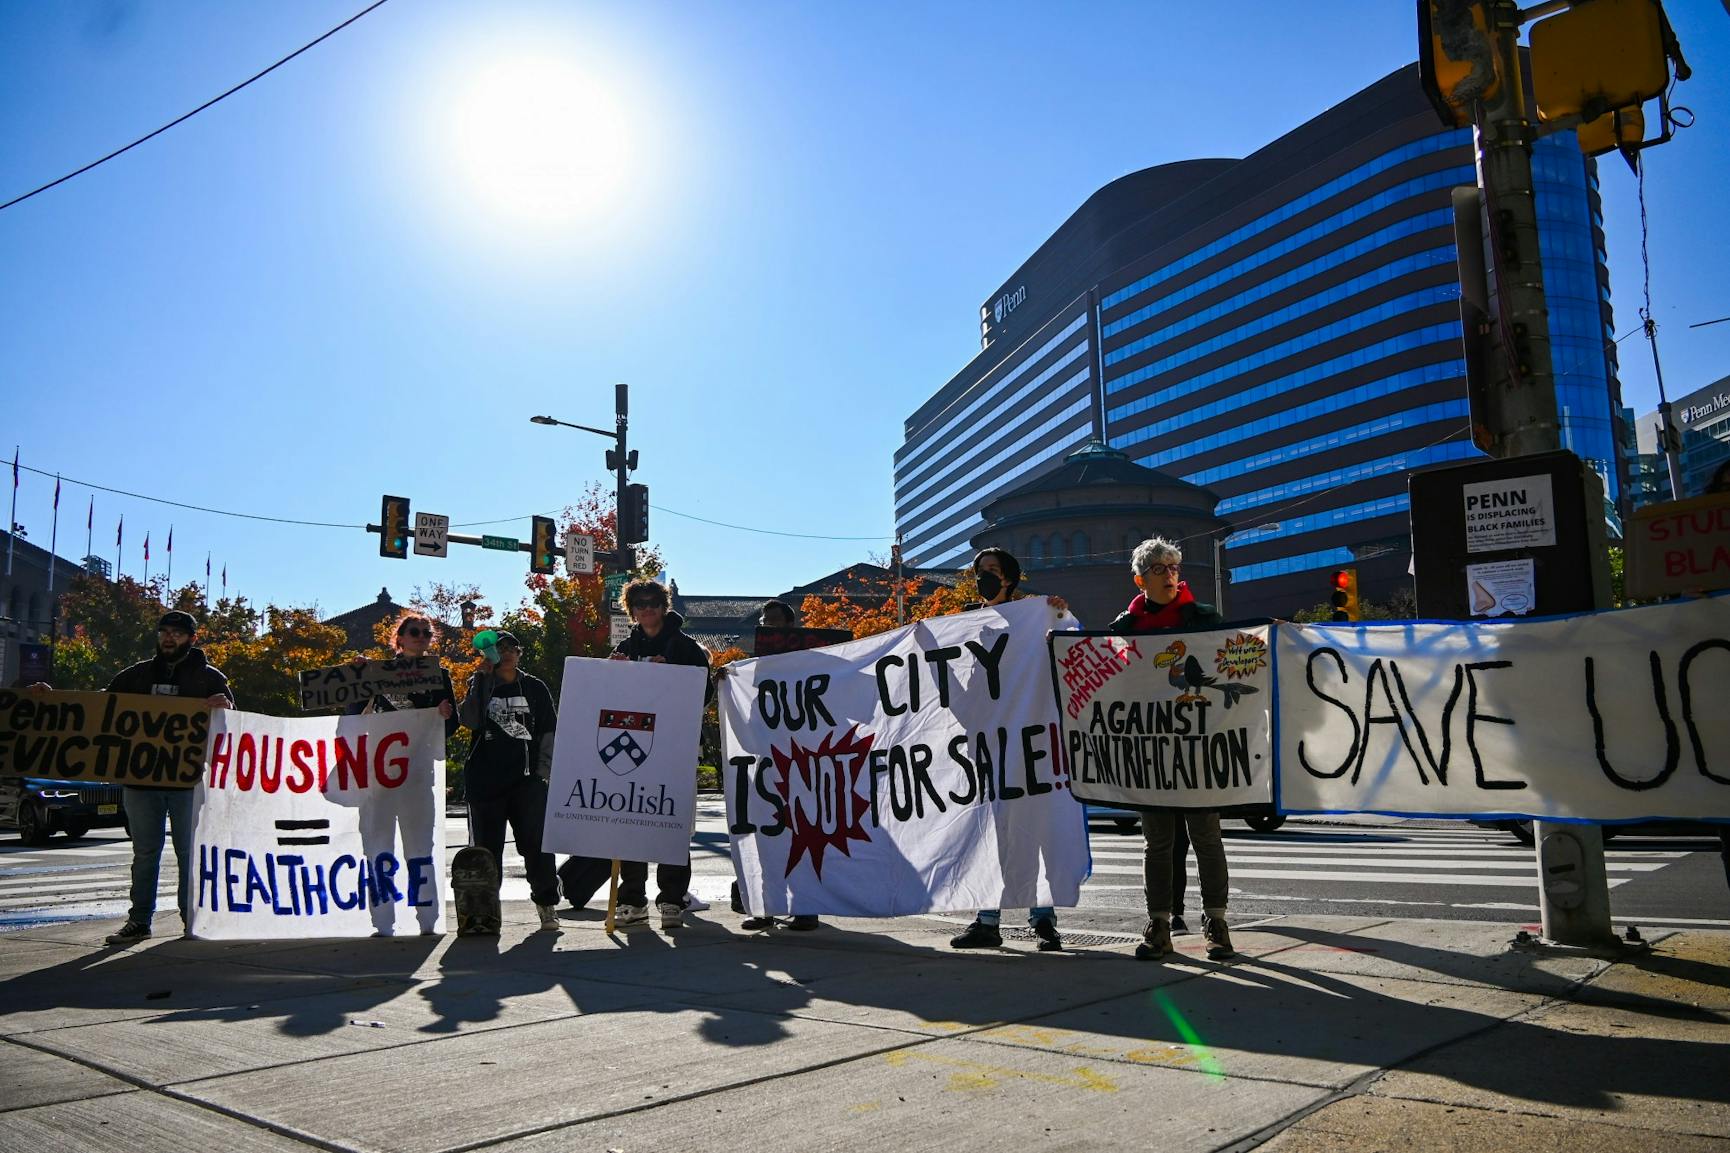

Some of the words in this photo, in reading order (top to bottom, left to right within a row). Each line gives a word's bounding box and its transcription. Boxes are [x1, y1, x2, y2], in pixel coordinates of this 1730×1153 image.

[1002, 285, 1026, 318] Penn
[1690, 403, 1712, 422] Penn
[1467, 489, 1527, 511] PENN
[421, 516, 443, 527] ONE
[1467, 524, 1498, 533] BLACK
[1501, 518, 1545, 530] FAMILIES
[1478, 506, 1536, 520] DISPLACING
[419, 528, 444, 540] WAY
[483, 537, 505, 549] 34th
[506, 540, 517, 550] St
[573, 536, 587, 547] NO
[570, 546, 589, 555] TURN
[574, 554, 585, 562] ON
[382, 657, 430, 671] SAVE
[1058, 636, 1095, 669] WEST
[1063, 639, 1117, 690] PHILLY
[302, 664, 367, 686] PAY
[758, 673, 837, 731] OUR
[875, 632, 1009, 717] CITY
[1067, 640, 1143, 720] COMMUNITY
[302, 681, 374, 706] PILOTS
[101, 693, 209, 744] loves
[1089, 700, 1212, 735] AGAINST
[1298, 646, 1529, 790] SAVE
[209, 731, 410, 794] HOUSING
[563, 778, 676, 817] Abolish
[729, 754, 785, 837] IS
[788, 752, 859, 836] NOT
[870, 743, 946, 828] FOR
[275, 819, 330, 846] =
[554, 811, 566, 819] the
[566, 812, 610, 823] UNIVERSITY
[611, 816, 618, 825] of
[619, 818, 683, 829] GENTRIFICATION
[198, 844, 434, 916] HEALTHCARE
